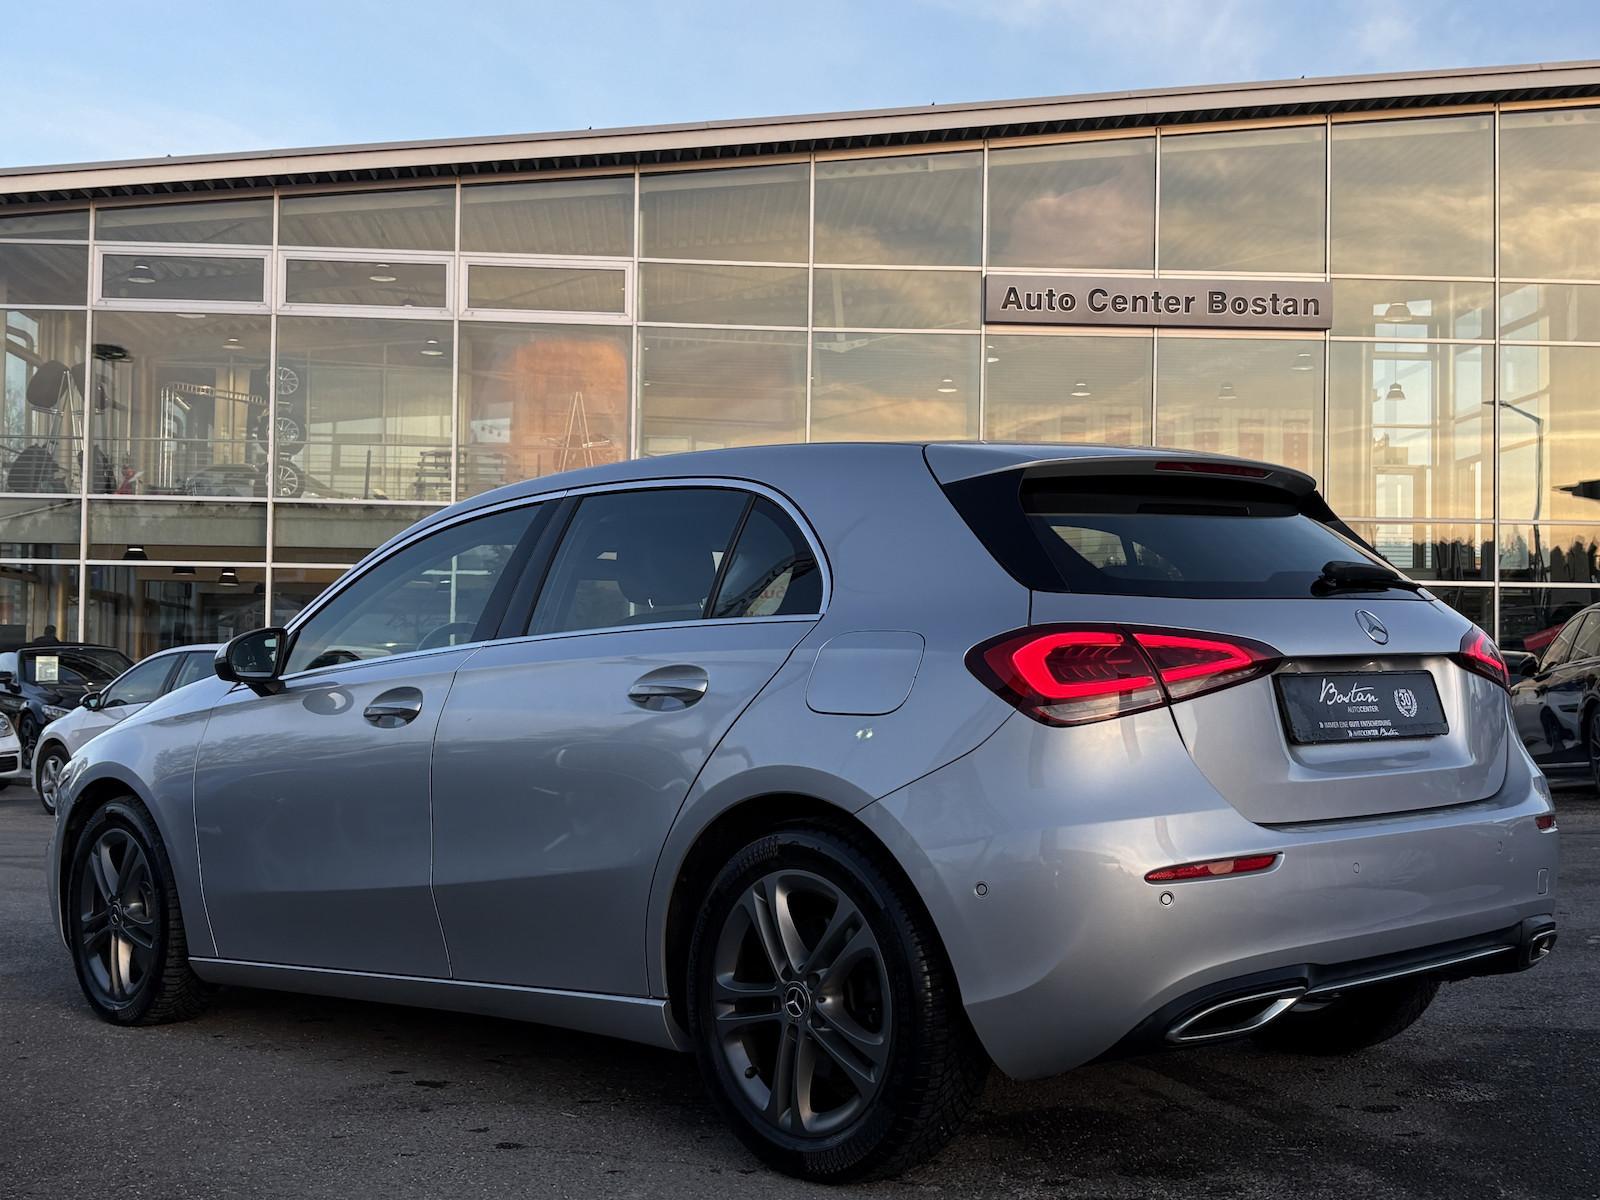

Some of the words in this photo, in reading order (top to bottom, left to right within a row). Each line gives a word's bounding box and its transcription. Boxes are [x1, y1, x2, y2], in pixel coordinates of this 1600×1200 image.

[1000, 286, 1077, 313] Auto
[1087, 287, 1195, 314] Center
[1207, 290, 1321, 317] Bostan
[1319, 678, 1379, 706] Bostan
[1399, 692, 1411, 706] 30
[1347, 705, 1380, 713] AUTOCENTER
